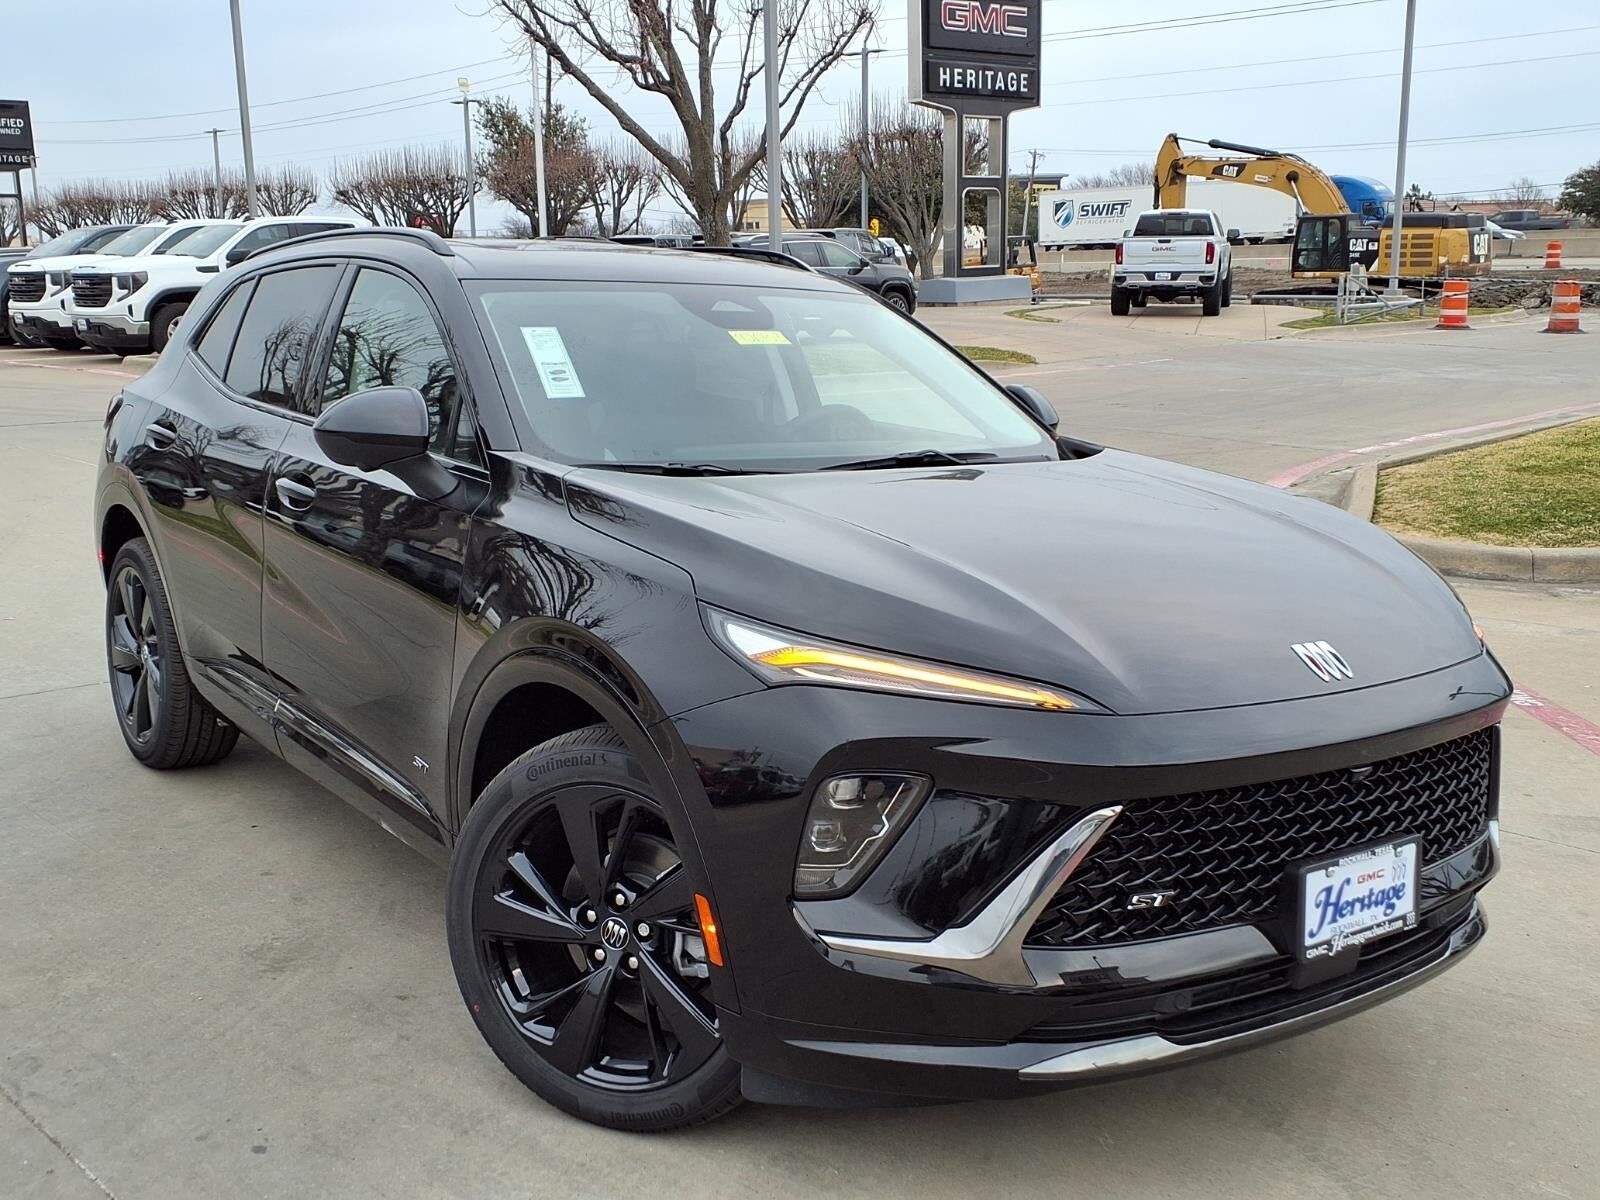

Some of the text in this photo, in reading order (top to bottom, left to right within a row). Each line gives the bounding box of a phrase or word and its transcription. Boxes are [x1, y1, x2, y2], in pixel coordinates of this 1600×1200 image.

[941, 0, 1028, 37] GMC
[939, 66, 1029, 92] HERITAGE
[0, 117, 24, 128] FIED
[1222, 164, 1239, 178] CAT
[1079, 201, 1130, 218] SWIFT
[1349, 238, 1369, 251] CAT
[1473, 233, 1489, 256] CAT
[526, 753, 597, 781] Continental
[1357, 868, 1385, 884] GMC
[1127, 891, 1175, 910] ST
[1308, 877, 1407, 939] Heritage
